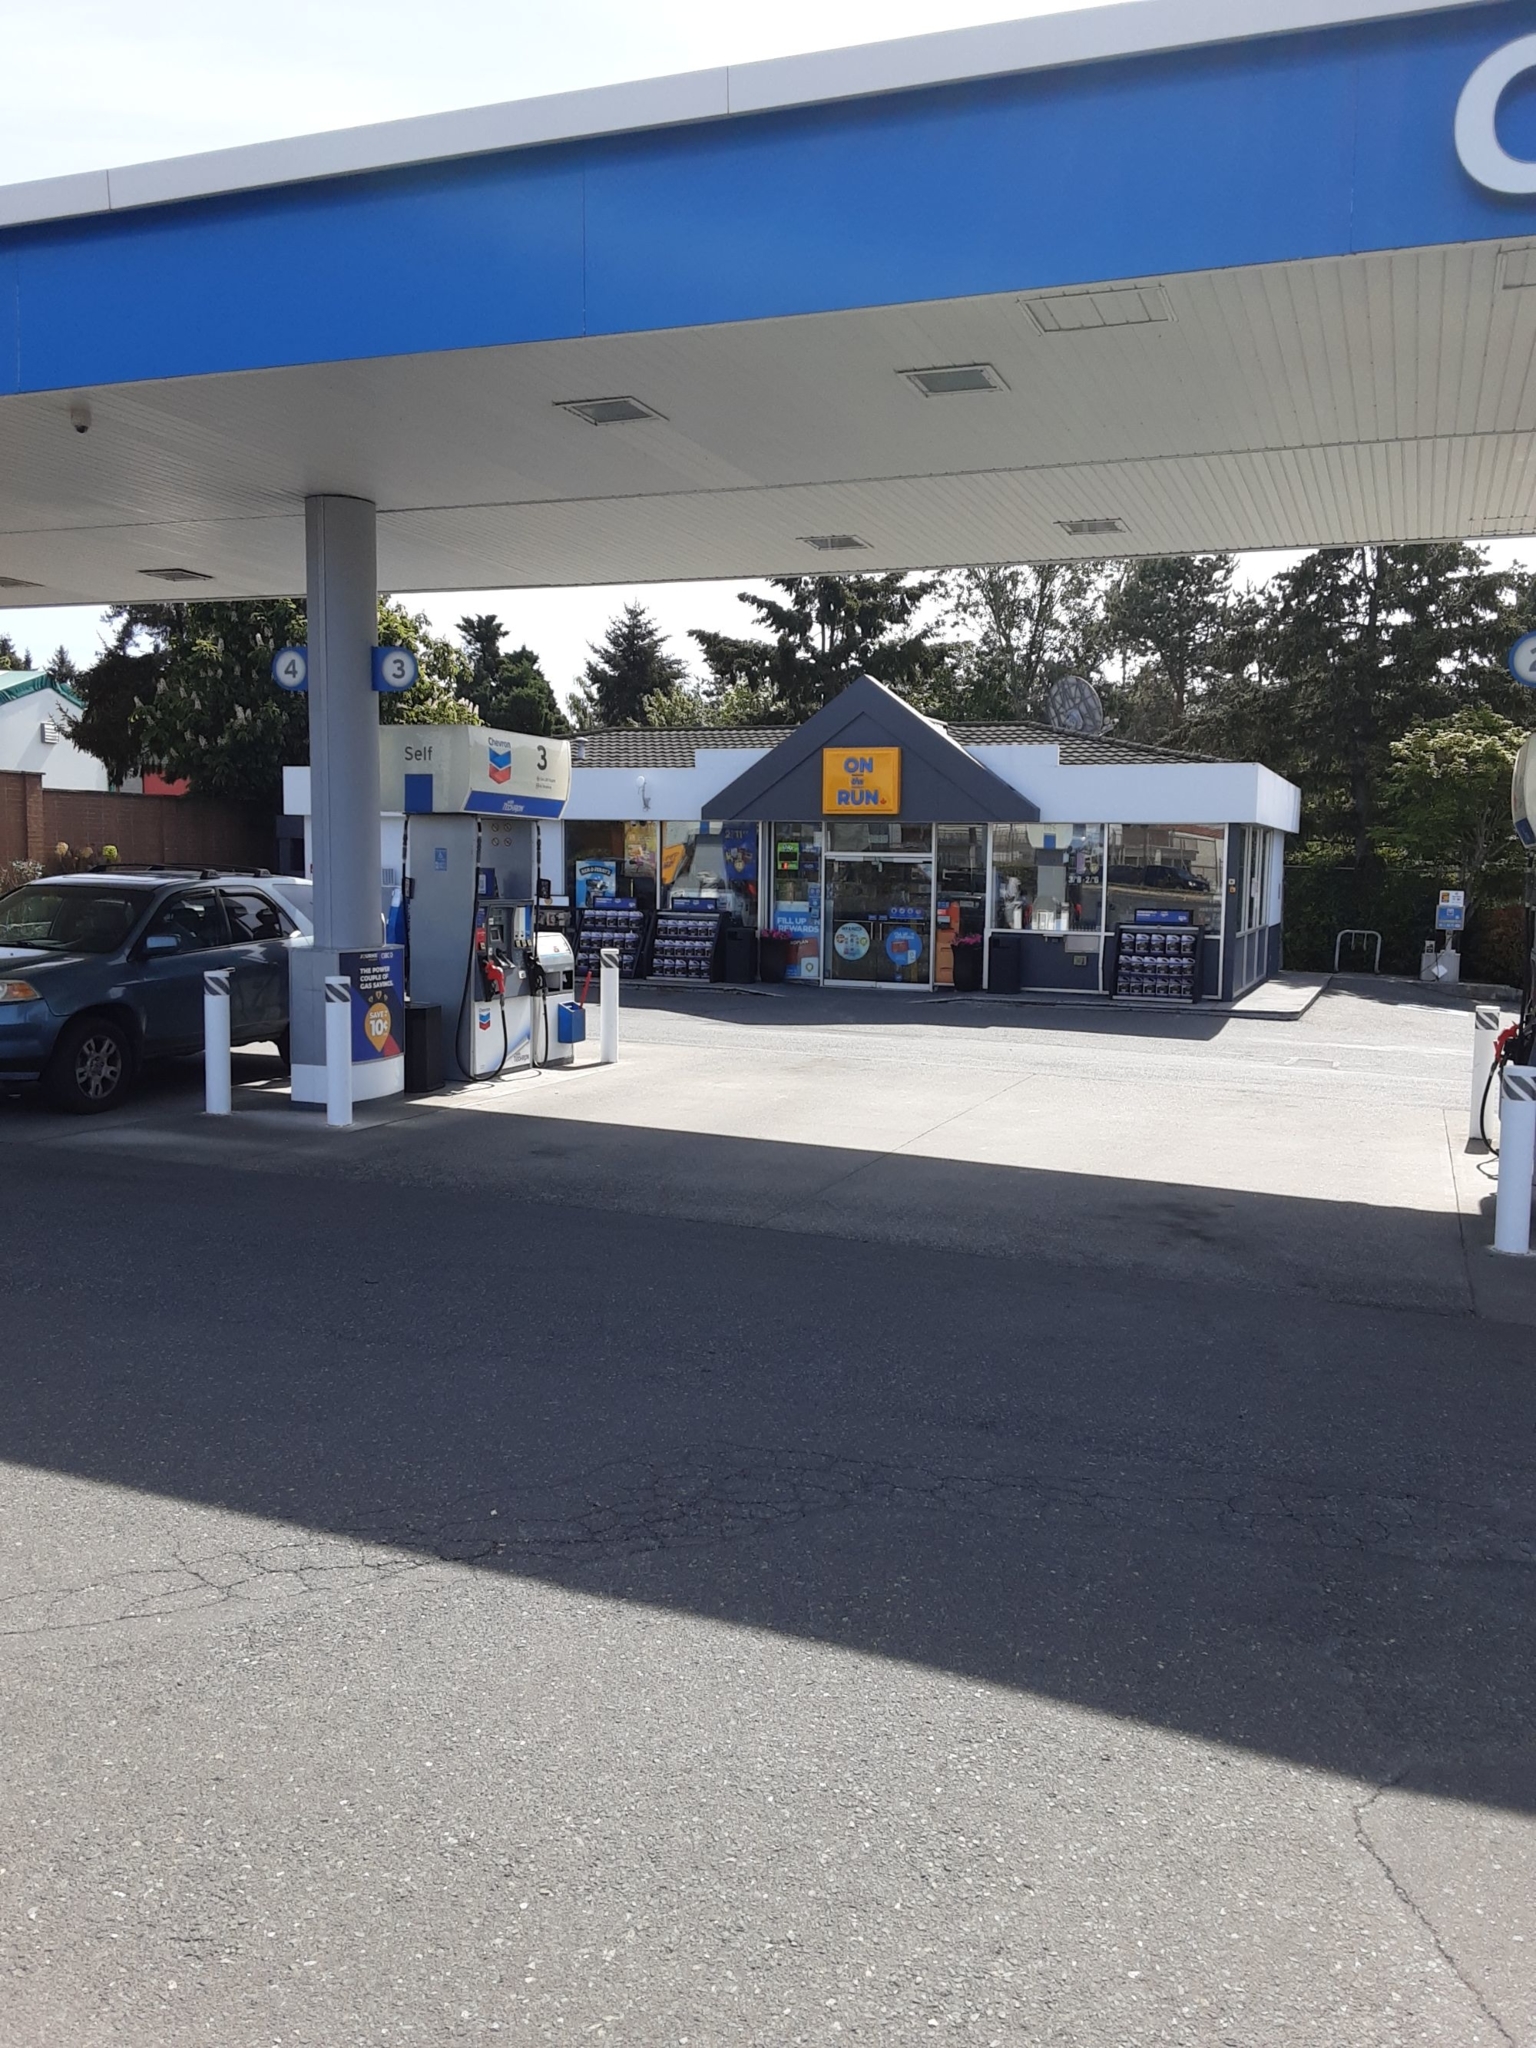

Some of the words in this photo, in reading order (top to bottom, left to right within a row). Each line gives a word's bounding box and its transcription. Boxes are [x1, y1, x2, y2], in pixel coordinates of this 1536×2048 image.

[284, 659, 297, 678] 4
[392, 659, 405, 679] 3
[488, 737, 511, 749] Chevron
[405, 747, 433, 761] Self
[537, 745, 547, 771] 3
[844, 757, 873, 773] ON
[837, 790, 879, 805] RUN
[778, 925, 819, 933] REWARDS
[360, 974, 381, 982] COUPLE
